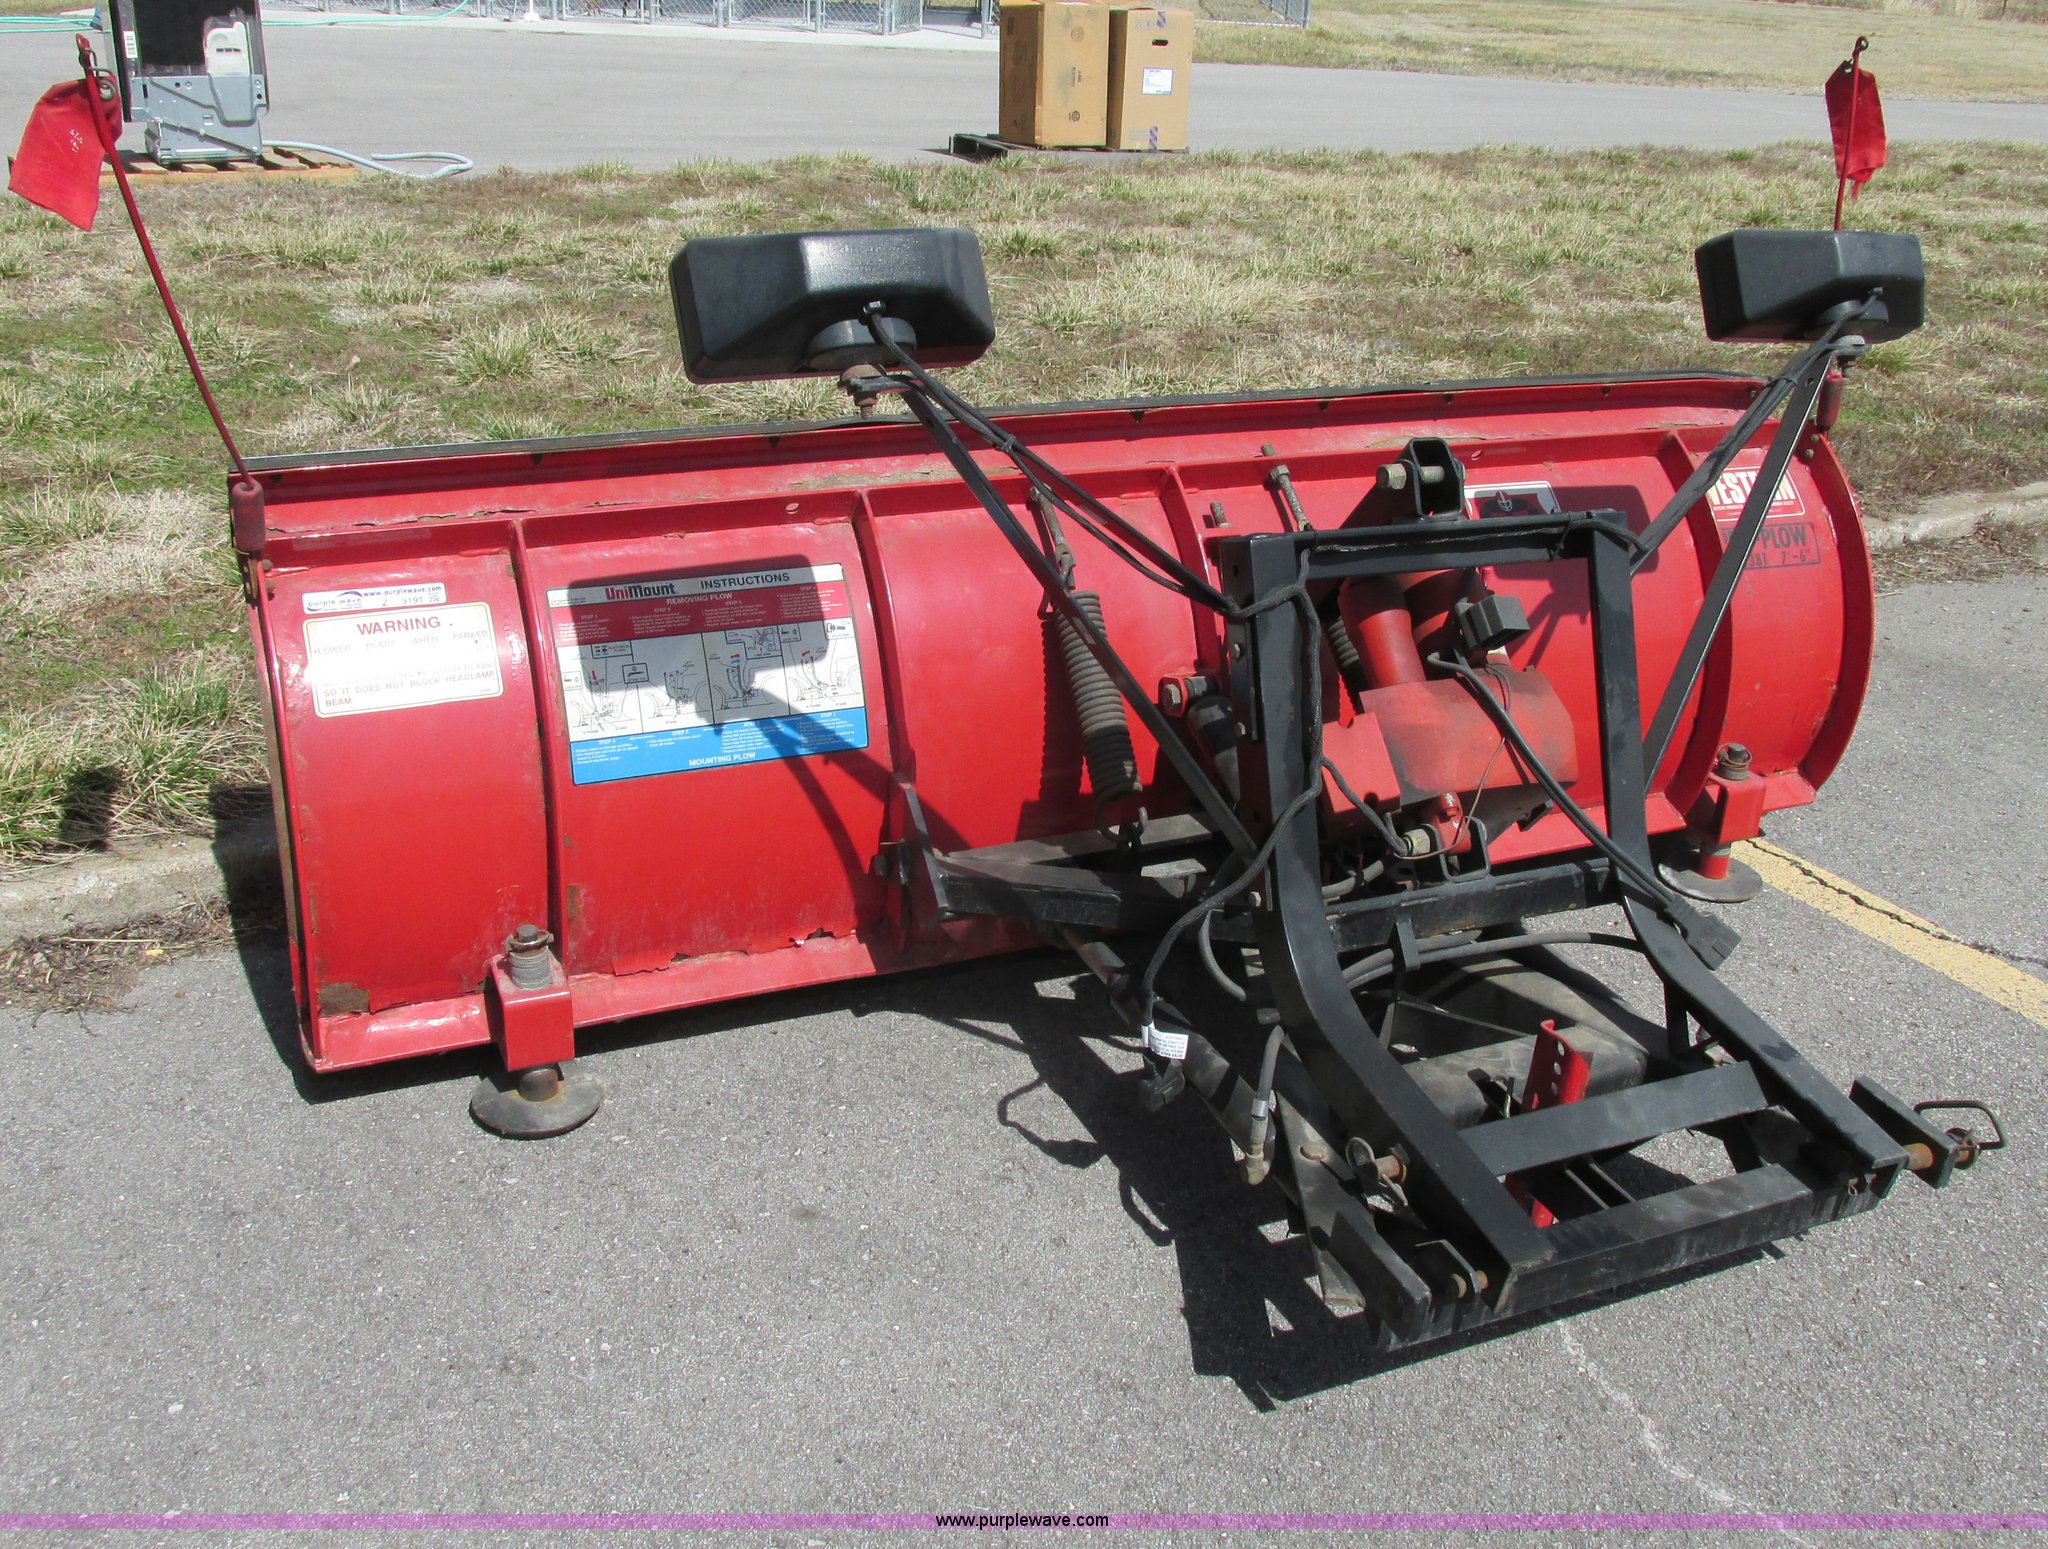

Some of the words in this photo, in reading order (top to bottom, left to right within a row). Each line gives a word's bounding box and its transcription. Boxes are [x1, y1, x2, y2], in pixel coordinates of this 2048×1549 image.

[1761, 525, 1807, 550] PLOW
[605, 583, 676, 600] UniMount
[700, 573, 791, 590] INSTRUCTIONS
[666, 594, 708, 605] REMOVING
[709, 592, 733, 601] PLOW
[356, 616, 441, 636] WARNING
[452, 630, 489, 641] PARKED
[323, 688, 337, 698] SO
[342, 686, 350, 696] IT
[355, 683, 382, 694] DOES
[385, 681, 405, 690] NOT
[409, 677, 441, 687] BLOCK
[445, 670, 496, 682] HEADLAMP
[325, 696, 353, 707] BEAM
[688, 754, 731, 767] MOUNTING
[733, 751, 756, 761] PLOW
